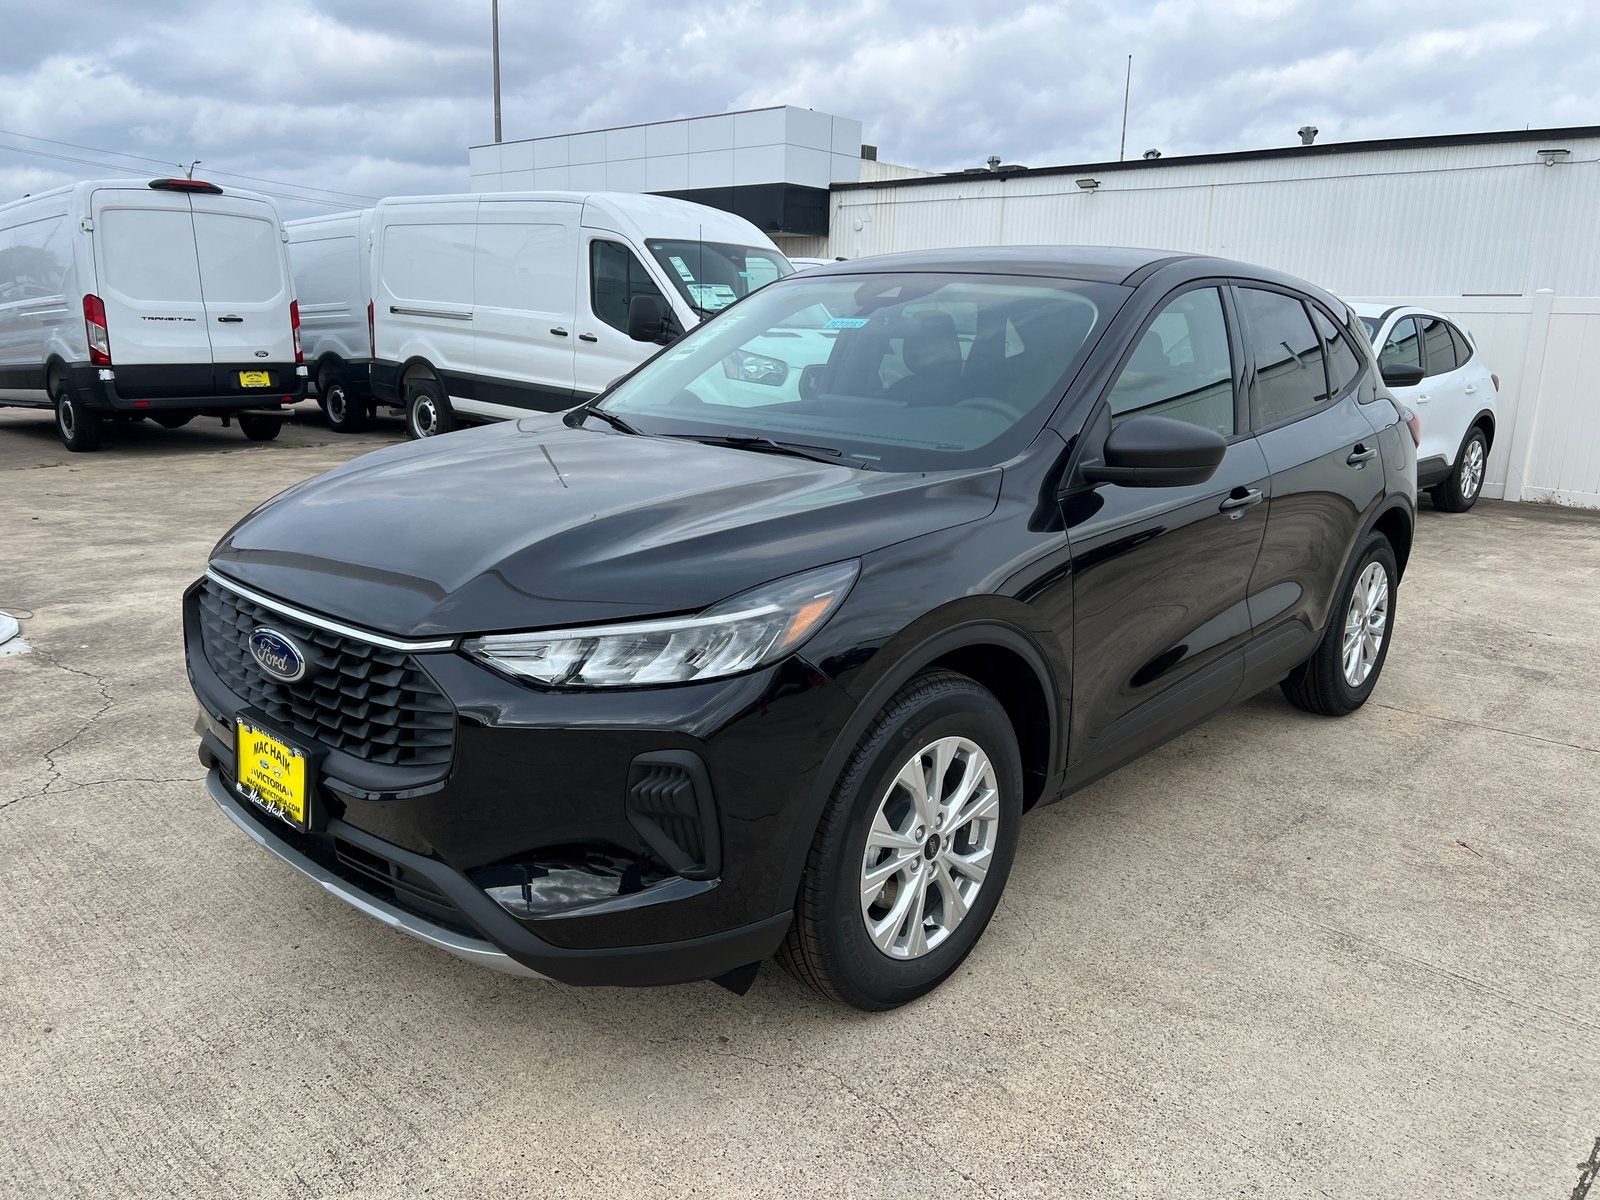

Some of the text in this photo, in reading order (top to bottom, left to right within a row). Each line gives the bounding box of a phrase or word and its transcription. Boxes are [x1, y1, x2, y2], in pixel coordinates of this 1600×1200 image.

[257, 637, 288, 671] Ford
[253, 741, 291, 775] MAC HAIK
[255, 770, 288, 795] VICTORIA
[248, 788, 266, 809] Mac
